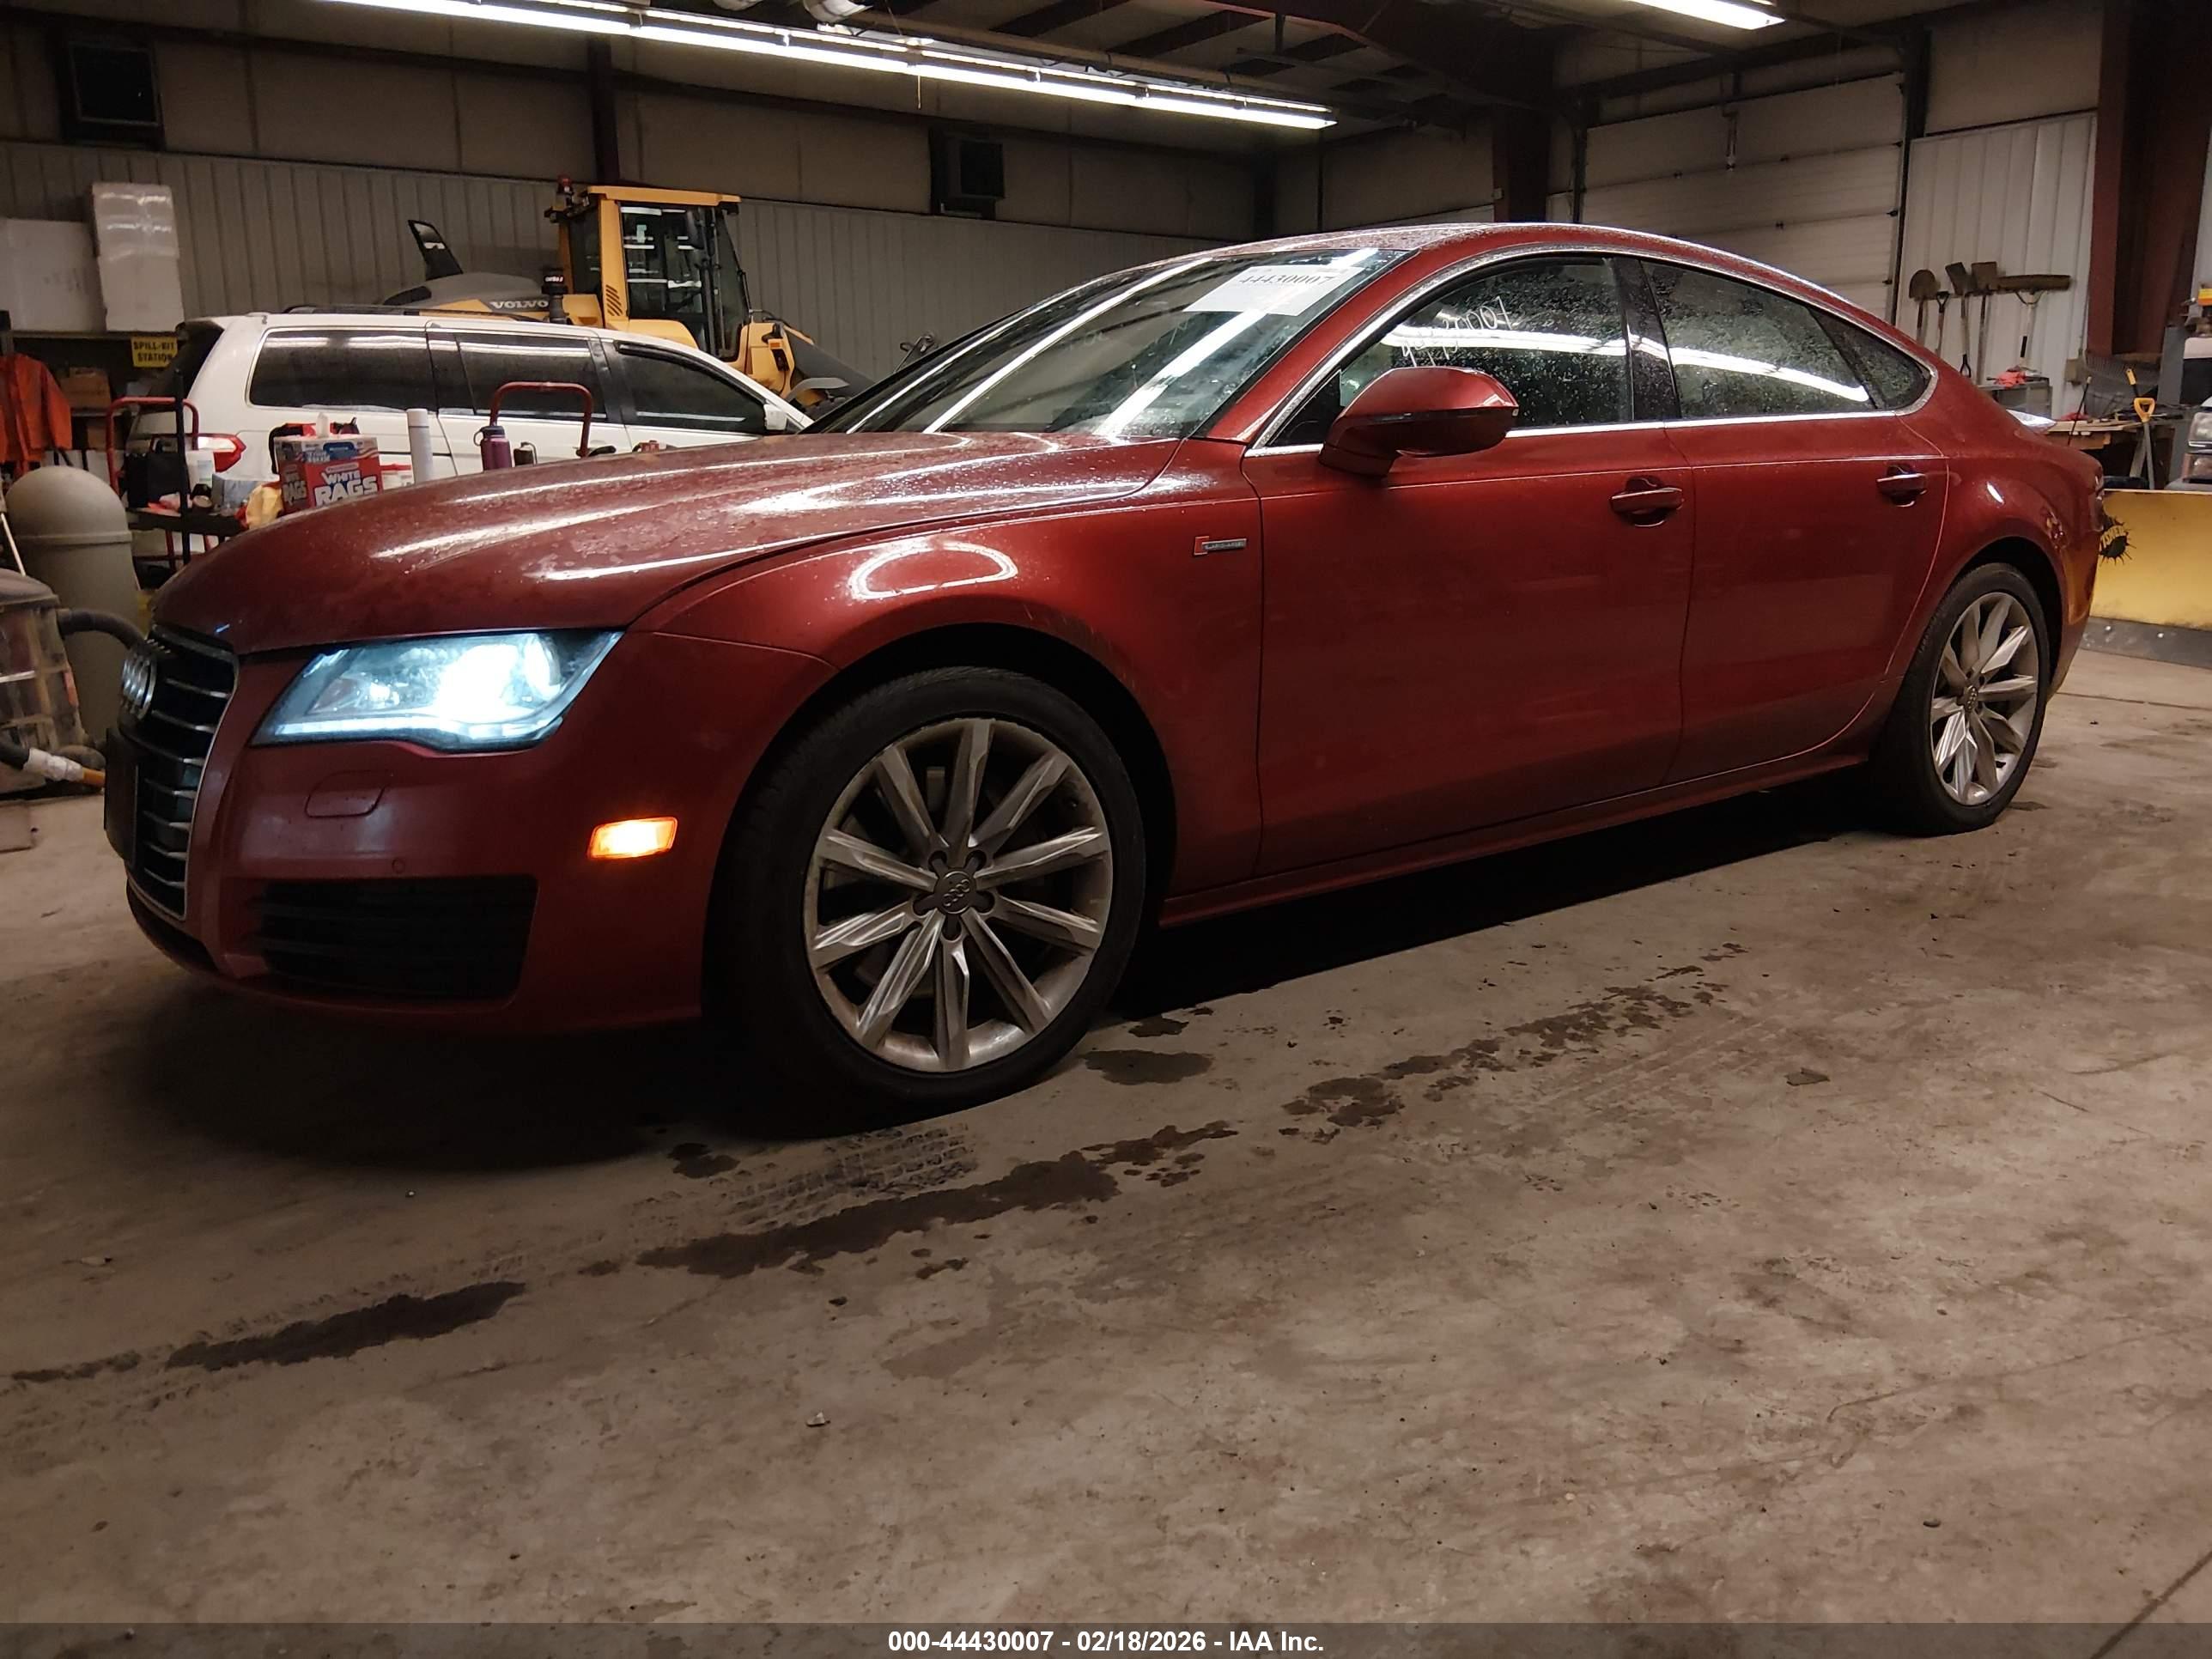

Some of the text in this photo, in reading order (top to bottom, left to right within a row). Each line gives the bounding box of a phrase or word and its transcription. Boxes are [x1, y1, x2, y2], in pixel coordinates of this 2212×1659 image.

[1238, 274, 1336, 285] 44430007
[489, 301, 549, 309] VOLVO
[321, 470, 361, 484] WHITE
[314, 476, 378, 507] RAGS
